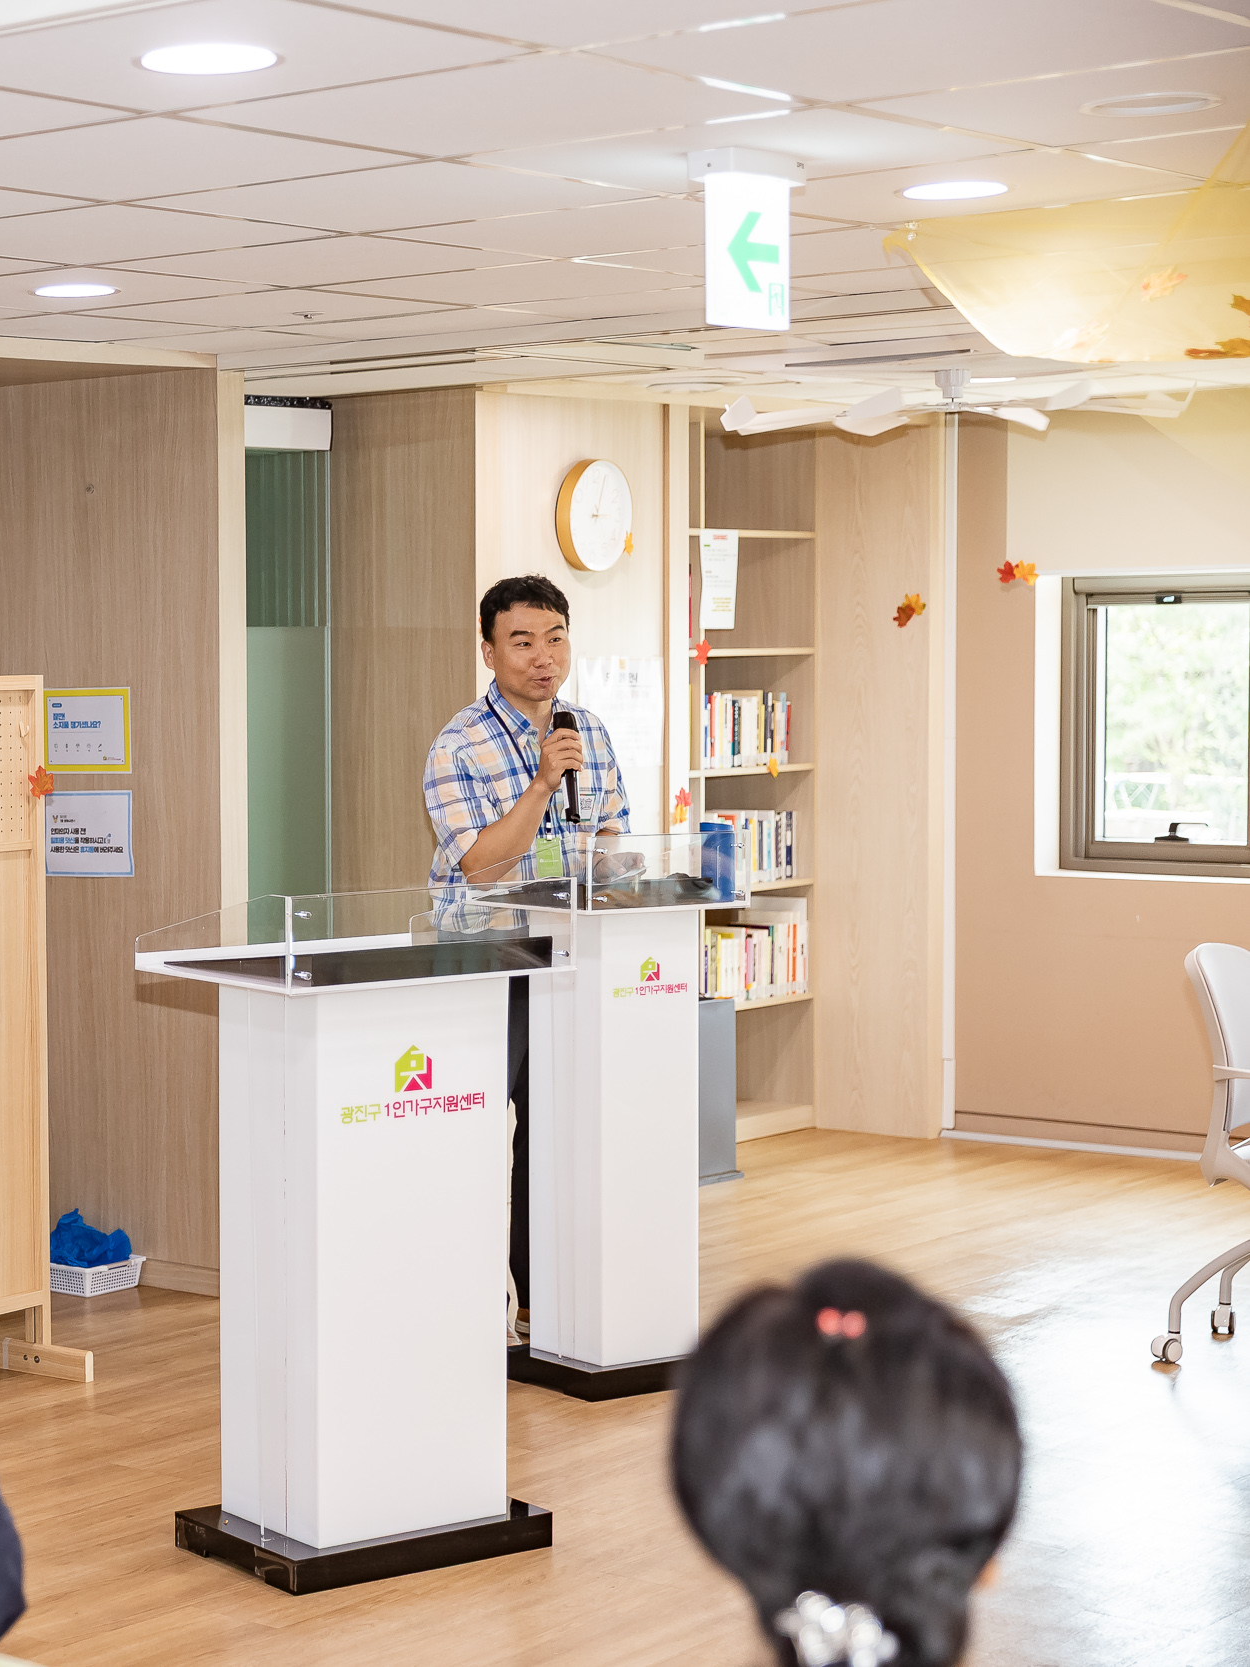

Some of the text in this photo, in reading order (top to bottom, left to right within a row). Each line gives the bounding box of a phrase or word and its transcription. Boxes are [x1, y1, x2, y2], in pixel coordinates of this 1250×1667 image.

[613, 983, 687, 998] 광진구 1인가구지원센터
[340, 1092, 485, 1124] 광진구 1인가구지원센터
